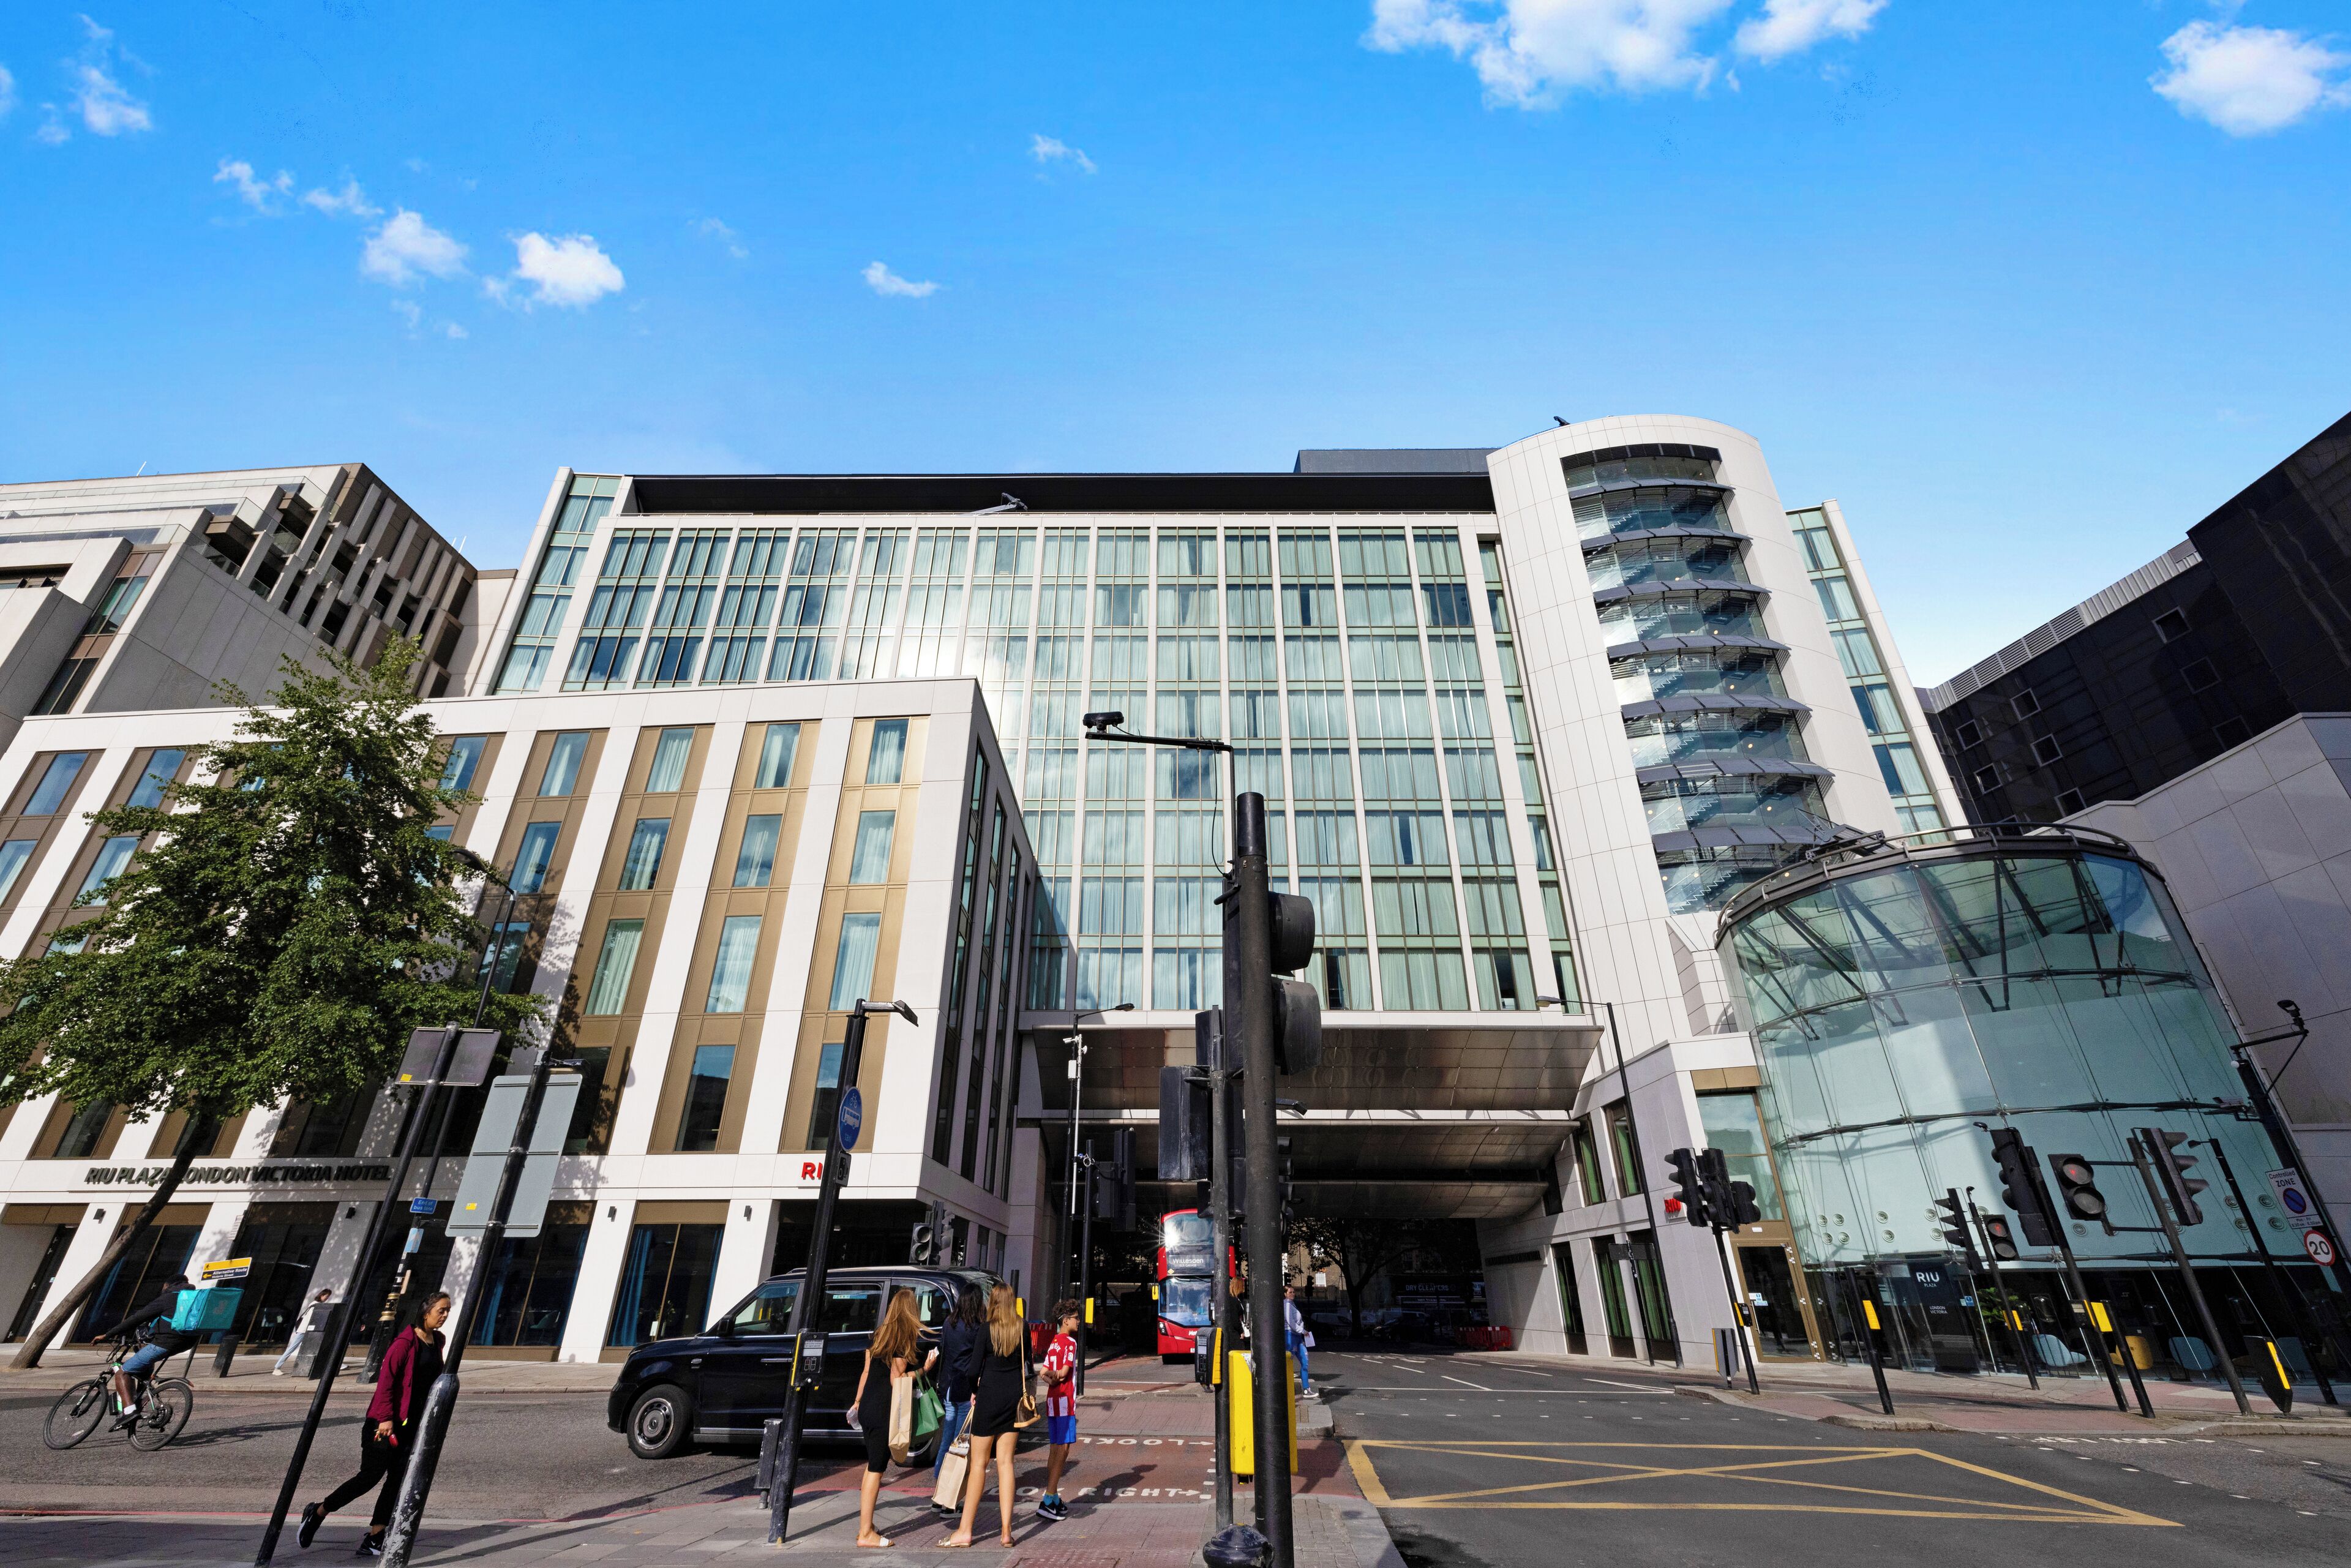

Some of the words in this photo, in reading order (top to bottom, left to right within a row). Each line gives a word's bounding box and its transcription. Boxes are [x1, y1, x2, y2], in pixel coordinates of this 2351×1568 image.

[84, 1167, 118, 1185] RIU
[114, 1167, 174, 1185] PLAZA
[179, 1166, 250, 1184] ONDON
[251, 1166, 332, 1182] VICTORIA
[332, 1165, 391, 1181] HOTEL
[801, 1162, 823, 1180] RI
[2269, 1171, 2295, 1179] Controlled
[2276, 1179, 2296, 1187] ZONE
[1664, 1198, 1682, 1214] RIU
[2309, 1240, 2330, 1255] 20
[1916, 1272, 1940, 1282] RIU
[1050, 1356, 1057, 1371] 7
[1078, 1487, 1181, 1497] RIGHT
